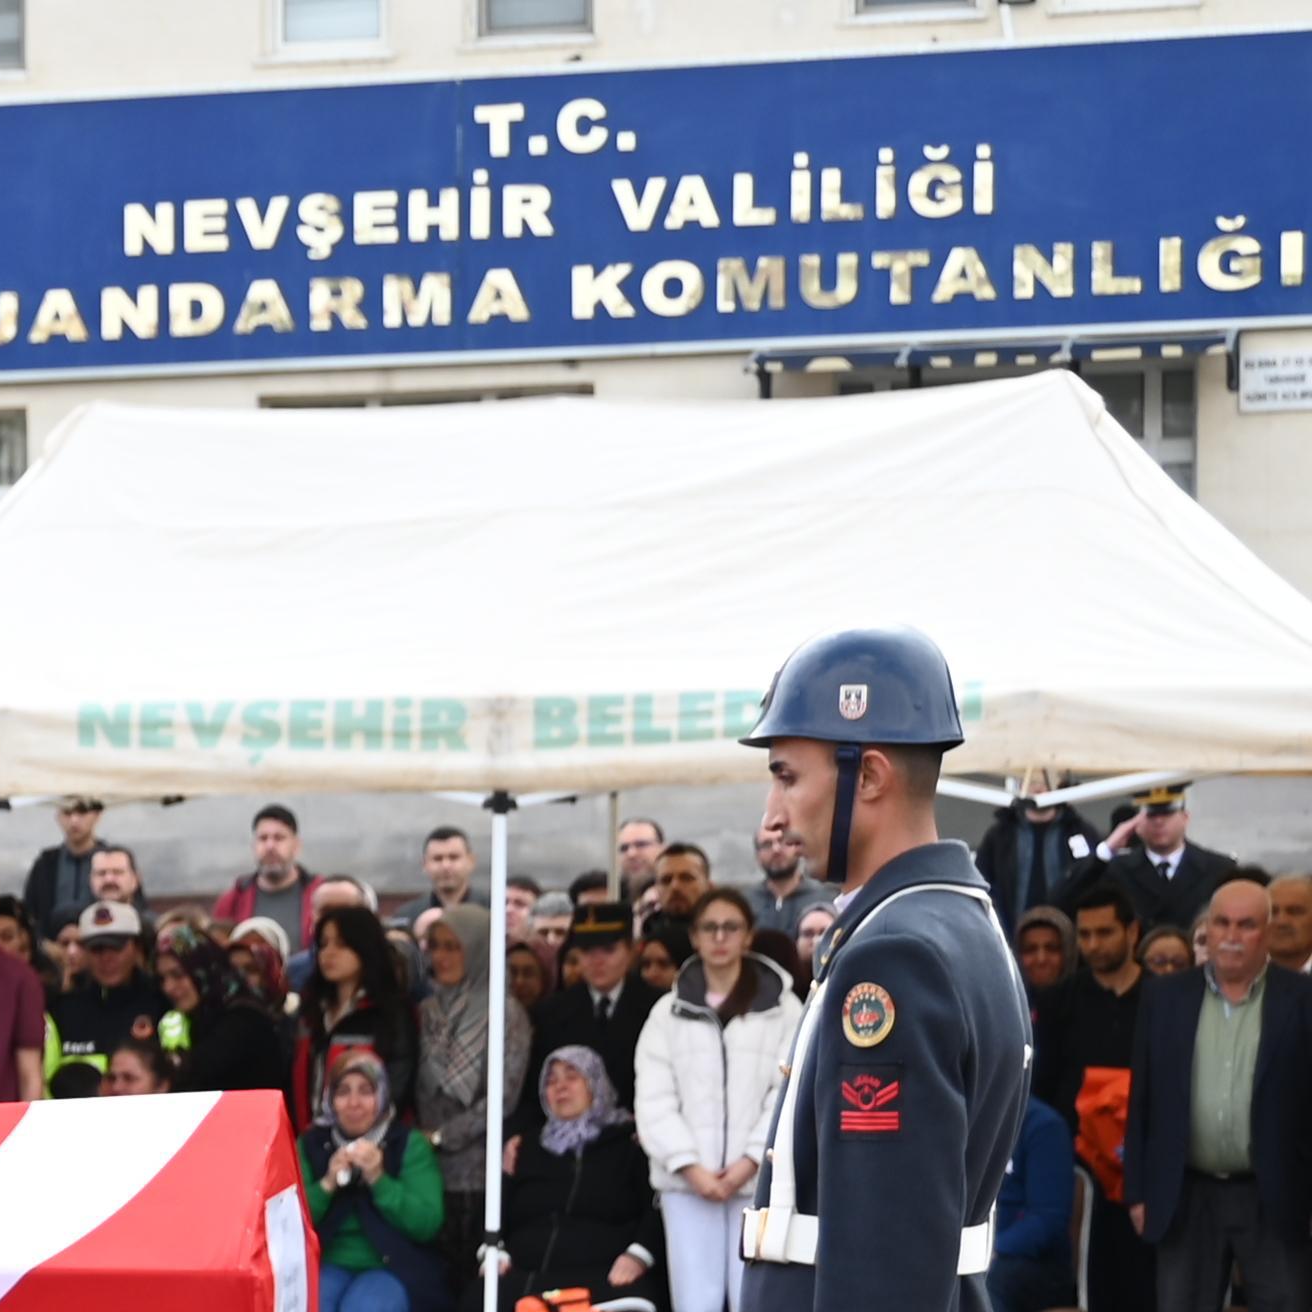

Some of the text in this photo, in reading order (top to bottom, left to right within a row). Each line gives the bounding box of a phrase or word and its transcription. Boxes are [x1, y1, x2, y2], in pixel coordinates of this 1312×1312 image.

[473, 97, 637, 158] T.C.
[123, 142, 995, 258] NEVŞEHİR VALİLİĞİ
[571, 214, 1306, 320] KOMUTANLIĞI
[77, 697, 470, 766] NEVŞEHİR
